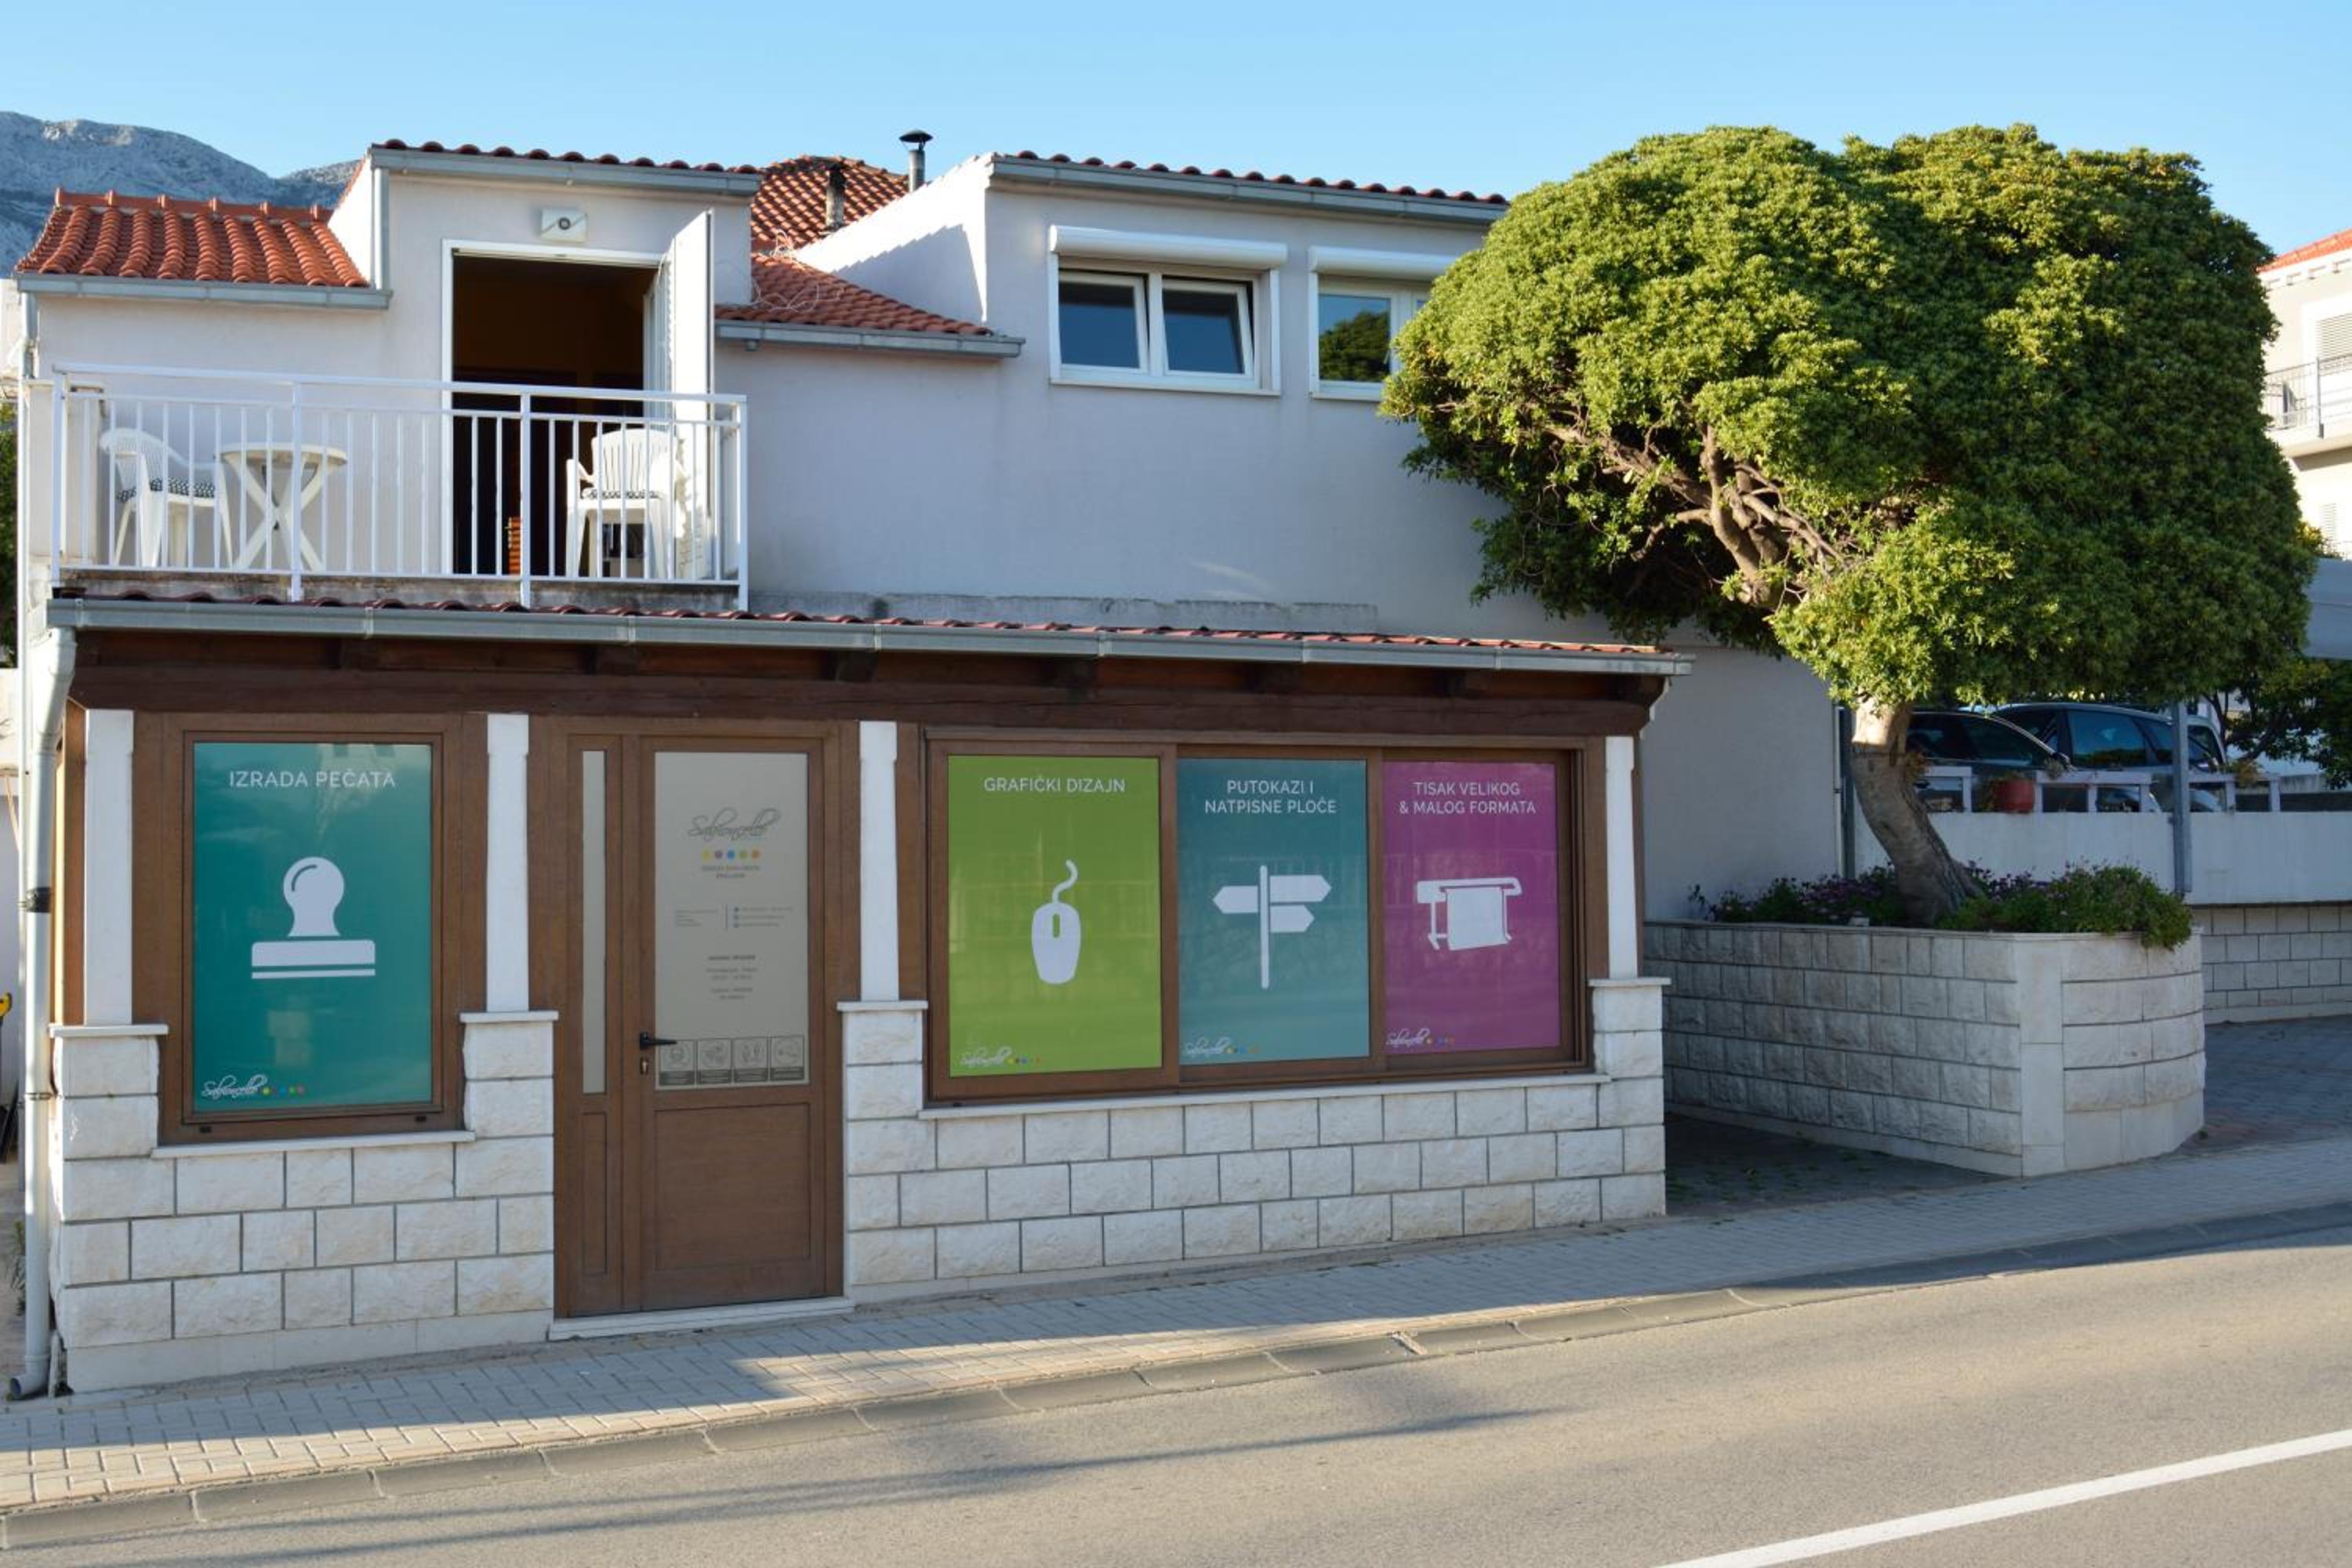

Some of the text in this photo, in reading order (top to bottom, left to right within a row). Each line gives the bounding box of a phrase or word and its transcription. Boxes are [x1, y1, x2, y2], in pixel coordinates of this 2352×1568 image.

[229, 768, 397, 788] IZRADA PEČATA
[983, 775, 1126, 793] GRAFIČKI DIZAJN
[1226, 780, 1314, 794] PUTOKAZI I
[1413, 781, 1521, 797] TISAK VELIKOG
[1204, 796, 1337, 814] NATPISNE PLOČE
[1399, 799, 1537, 815] & MALOG FORMATA
